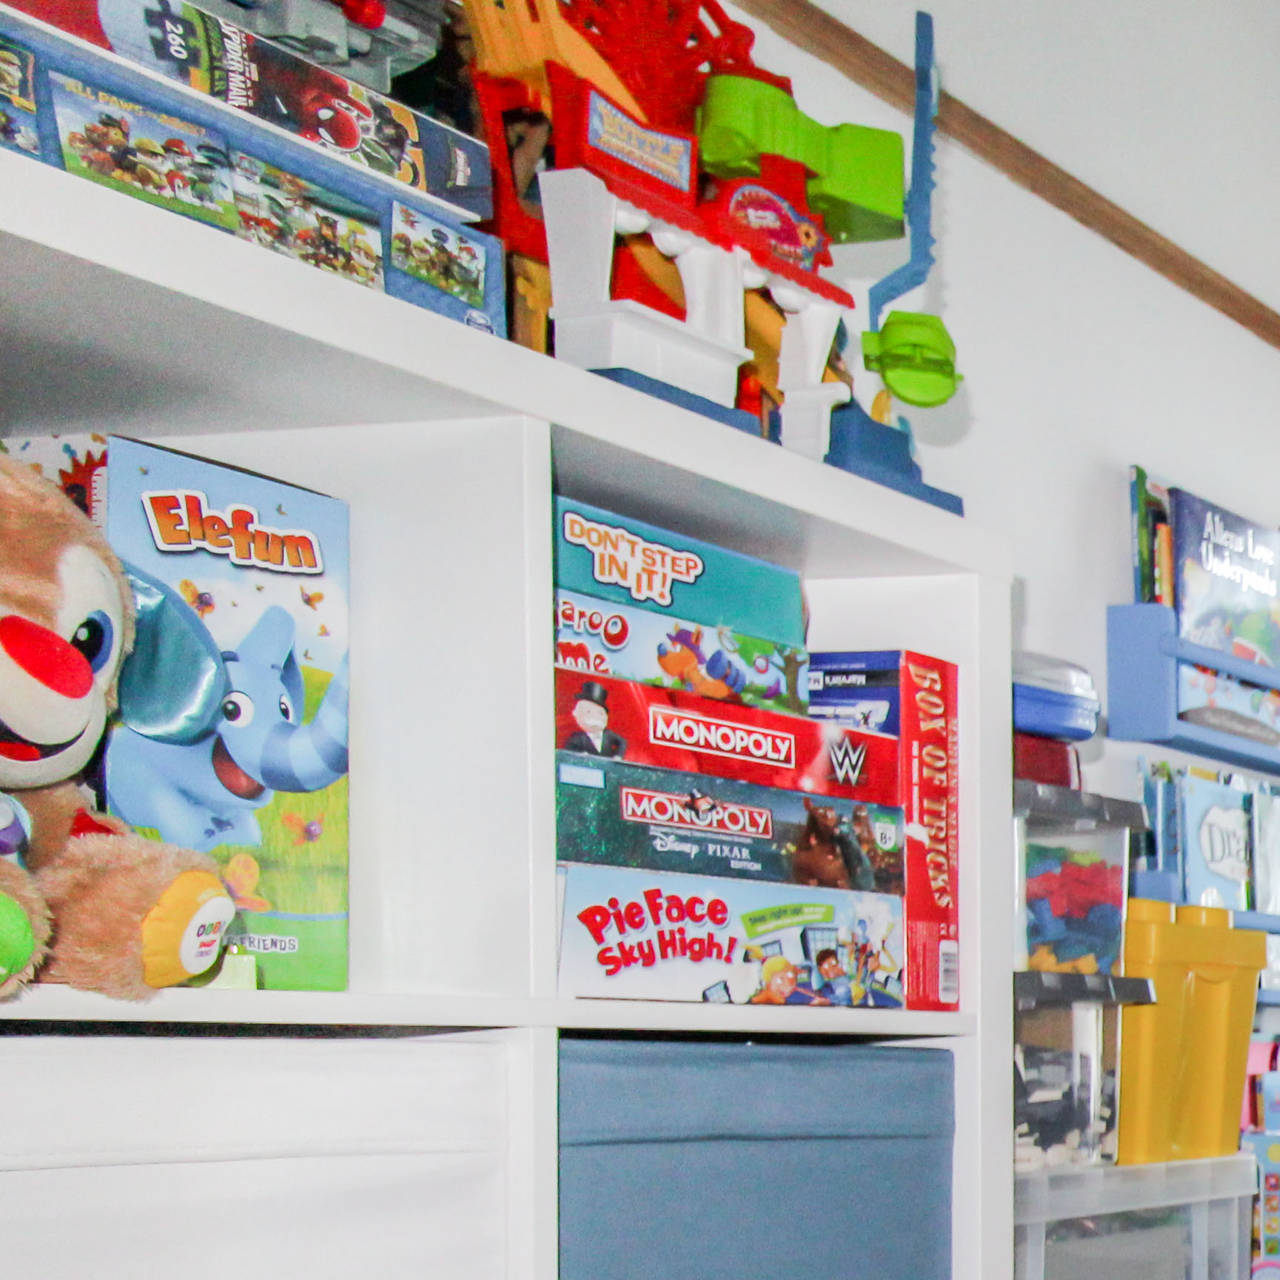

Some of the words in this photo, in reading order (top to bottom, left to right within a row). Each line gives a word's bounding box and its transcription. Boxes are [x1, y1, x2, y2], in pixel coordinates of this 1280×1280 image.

[165, 19, 188, 60] 260
[149, 494, 318, 569] Elefun
[568, 518, 638, 557] DON'T
[641, 546, 698, 577] STEP
[599, 552, 629, 581] IN
[635, 567, 668, 600] IT!
[909, 664, 947, 737] BOX
[655, 714, 791, 761] MONOPOLY
[922, 744, 949, 788] OF
[626, 791, 769, 834] MONOPOLY
[650, 831, 701, 859] Disney
[707, 843, 752, 860] PIXAR
[923, 797, 954, 909] TRICKS
[577, 897, 645, 945] Pie
[643, 888, 729, 927] Face
[597, 939, 656, 977] Sky
[656, 926, 738, 964] High!
